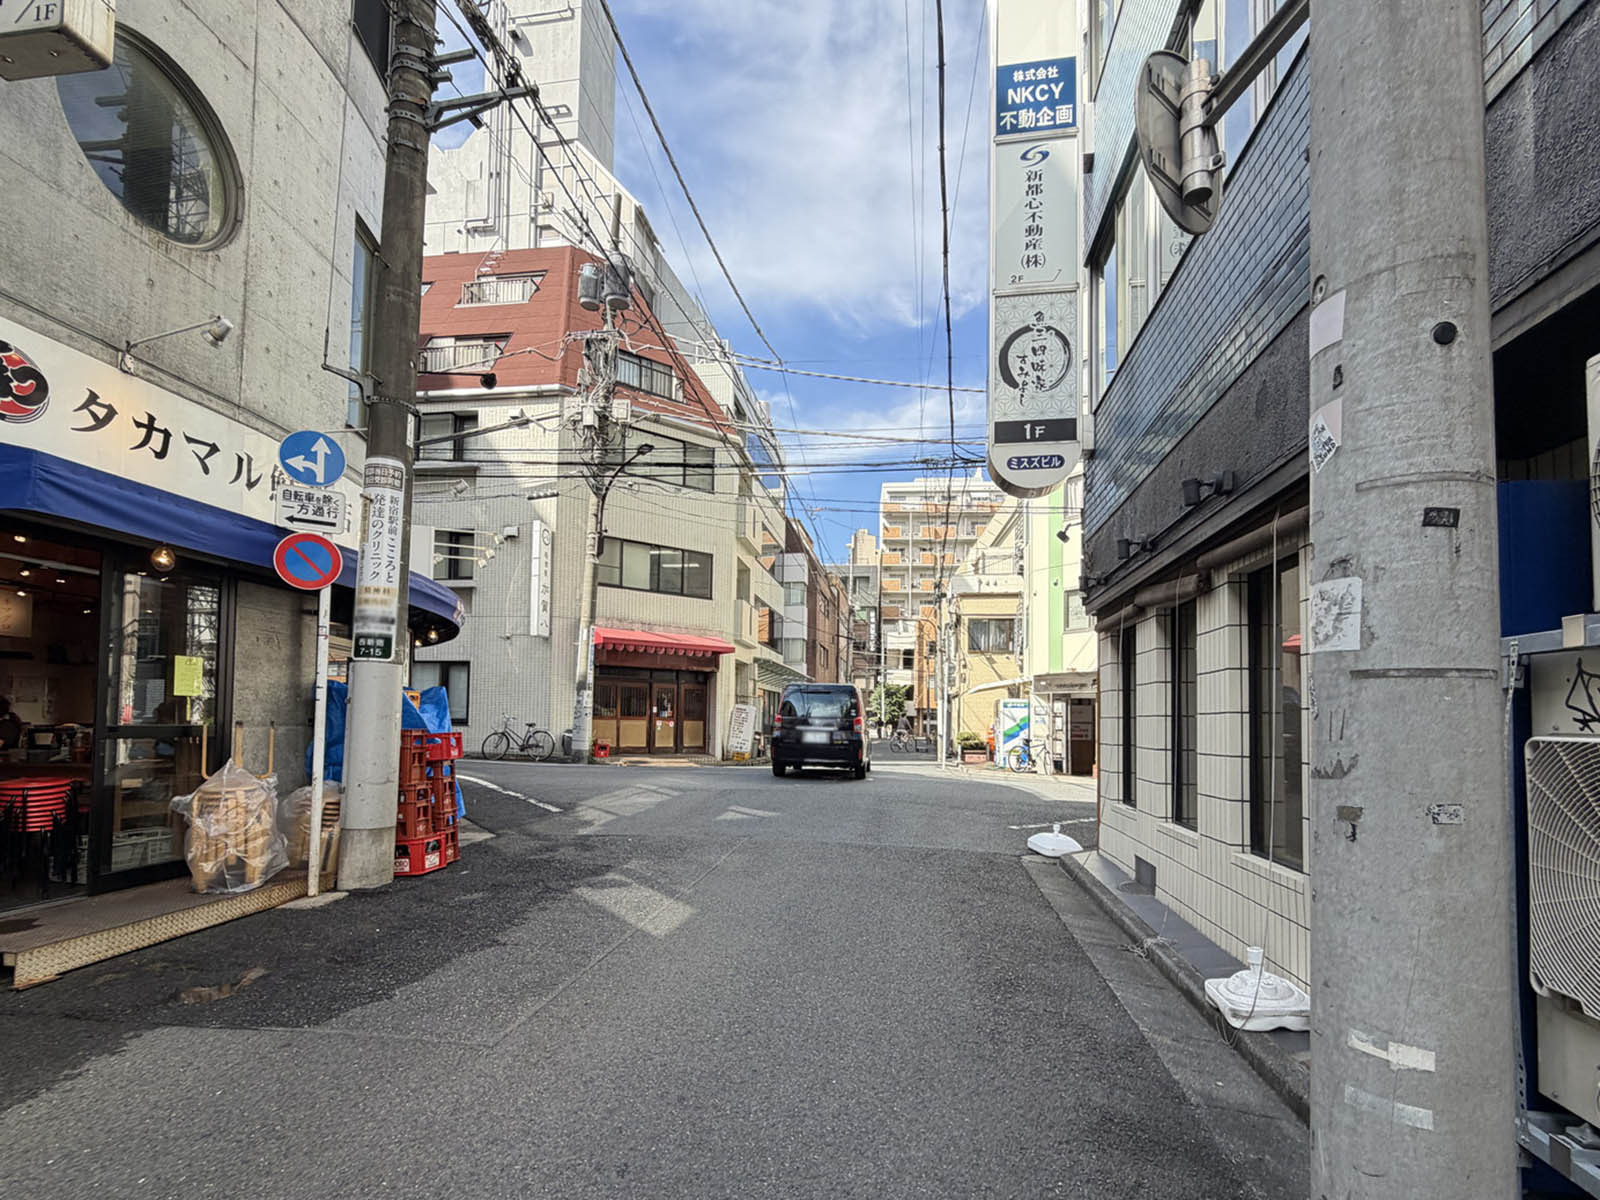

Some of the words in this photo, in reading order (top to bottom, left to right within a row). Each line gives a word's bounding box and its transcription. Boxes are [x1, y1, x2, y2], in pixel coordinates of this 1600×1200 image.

[33, 3, 58, 21] 1F
[1013, 66, 1059, 83] 株式会社
[1007, 82, 1065, 105] NKCY
[1000, 104, 1074, 130] 不動企画
[1021, 168, 1047, 269] 新都心不動産(株)
[1010, 274, 1024, 284] 2F
[1023, 423, 1046, 440] 1F
[1009, 455, 1063, 470] ミスズビル
[282, 488, 340, 507] 自転車を除く
[281, 503, 339, 519] 一方通行
[369, 493, 386, 581] 発達のクリニック
[359, 647, 383, 657] 7-15
